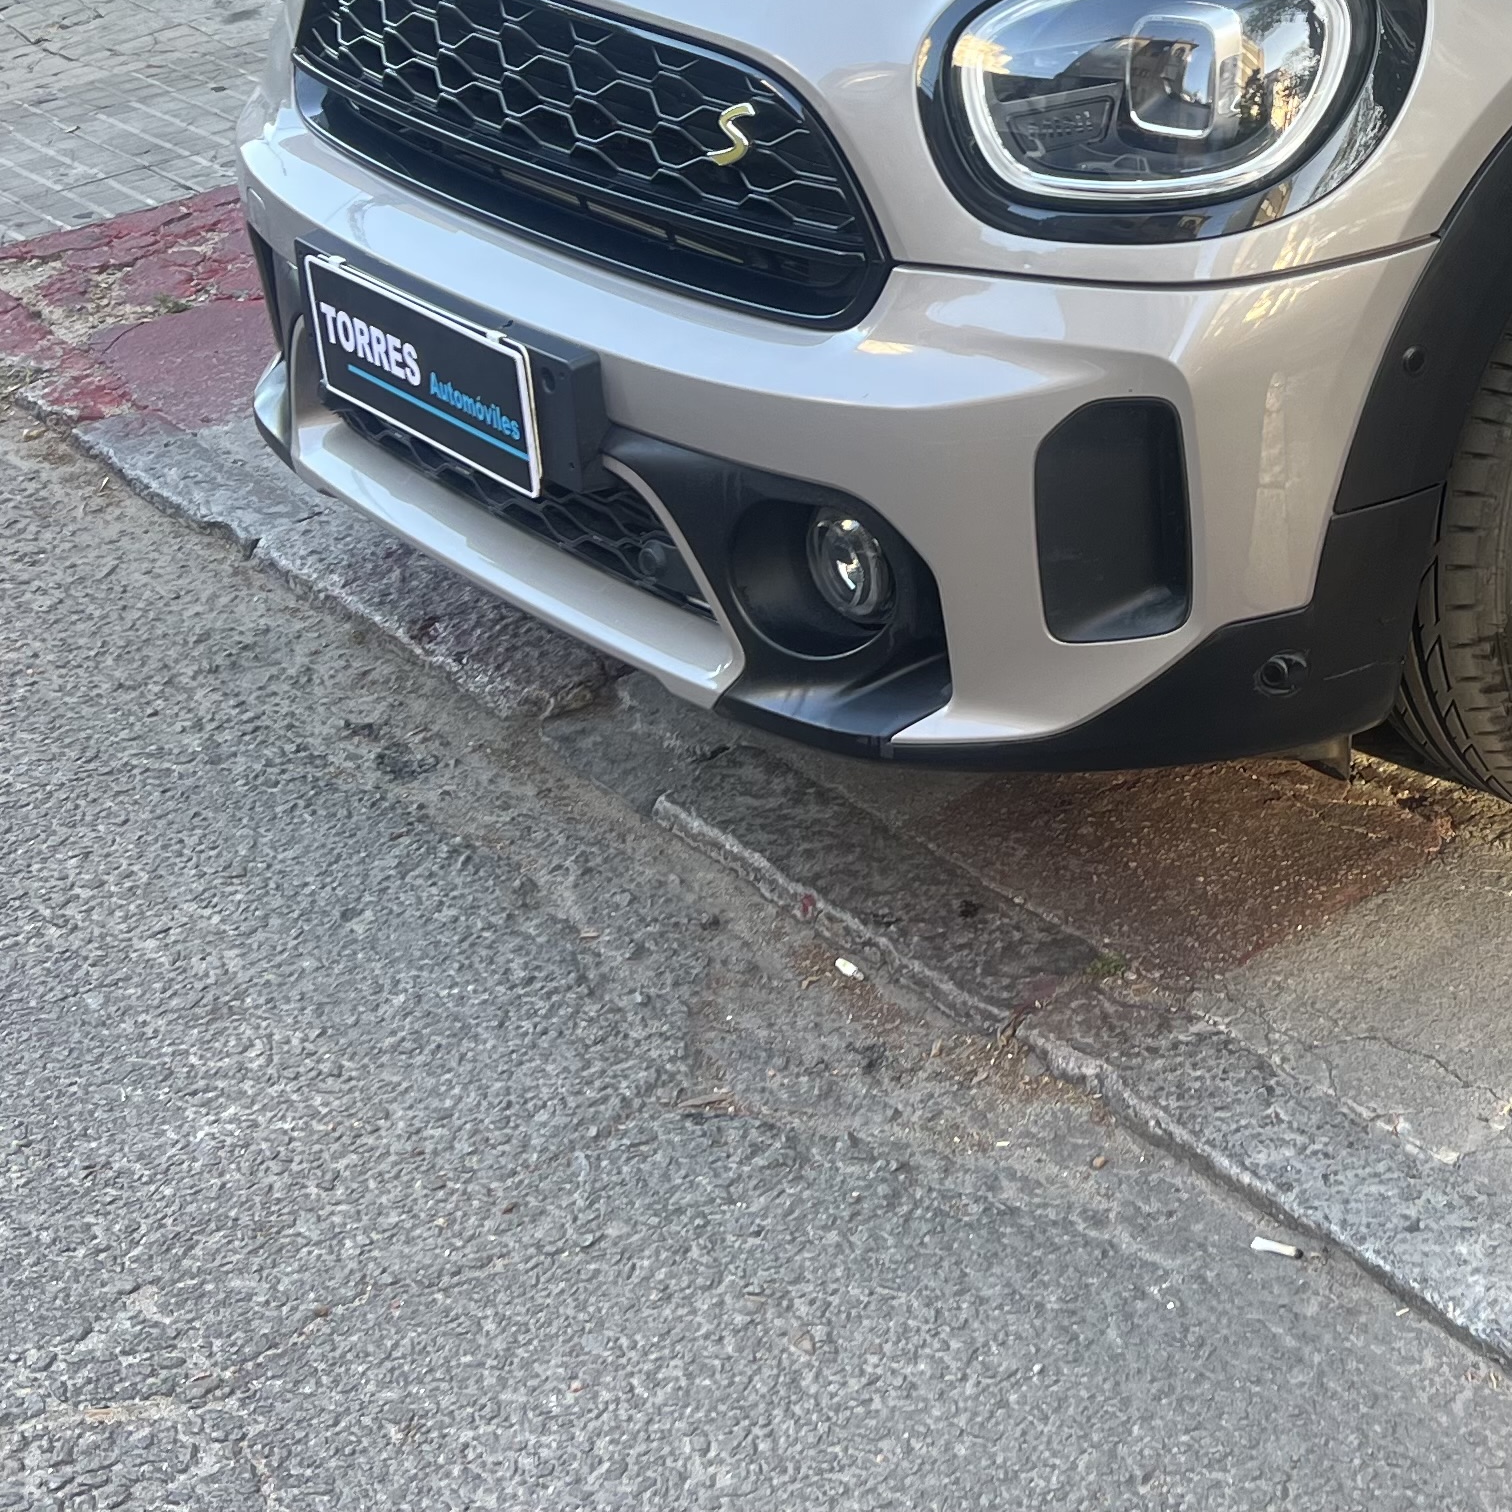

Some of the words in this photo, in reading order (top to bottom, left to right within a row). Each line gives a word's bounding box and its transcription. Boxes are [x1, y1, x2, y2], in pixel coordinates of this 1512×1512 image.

[707, 102, 756, 167] S
[319, 301, 421, 387] TORRES
[429, 371, 521, 441] Automóviles
